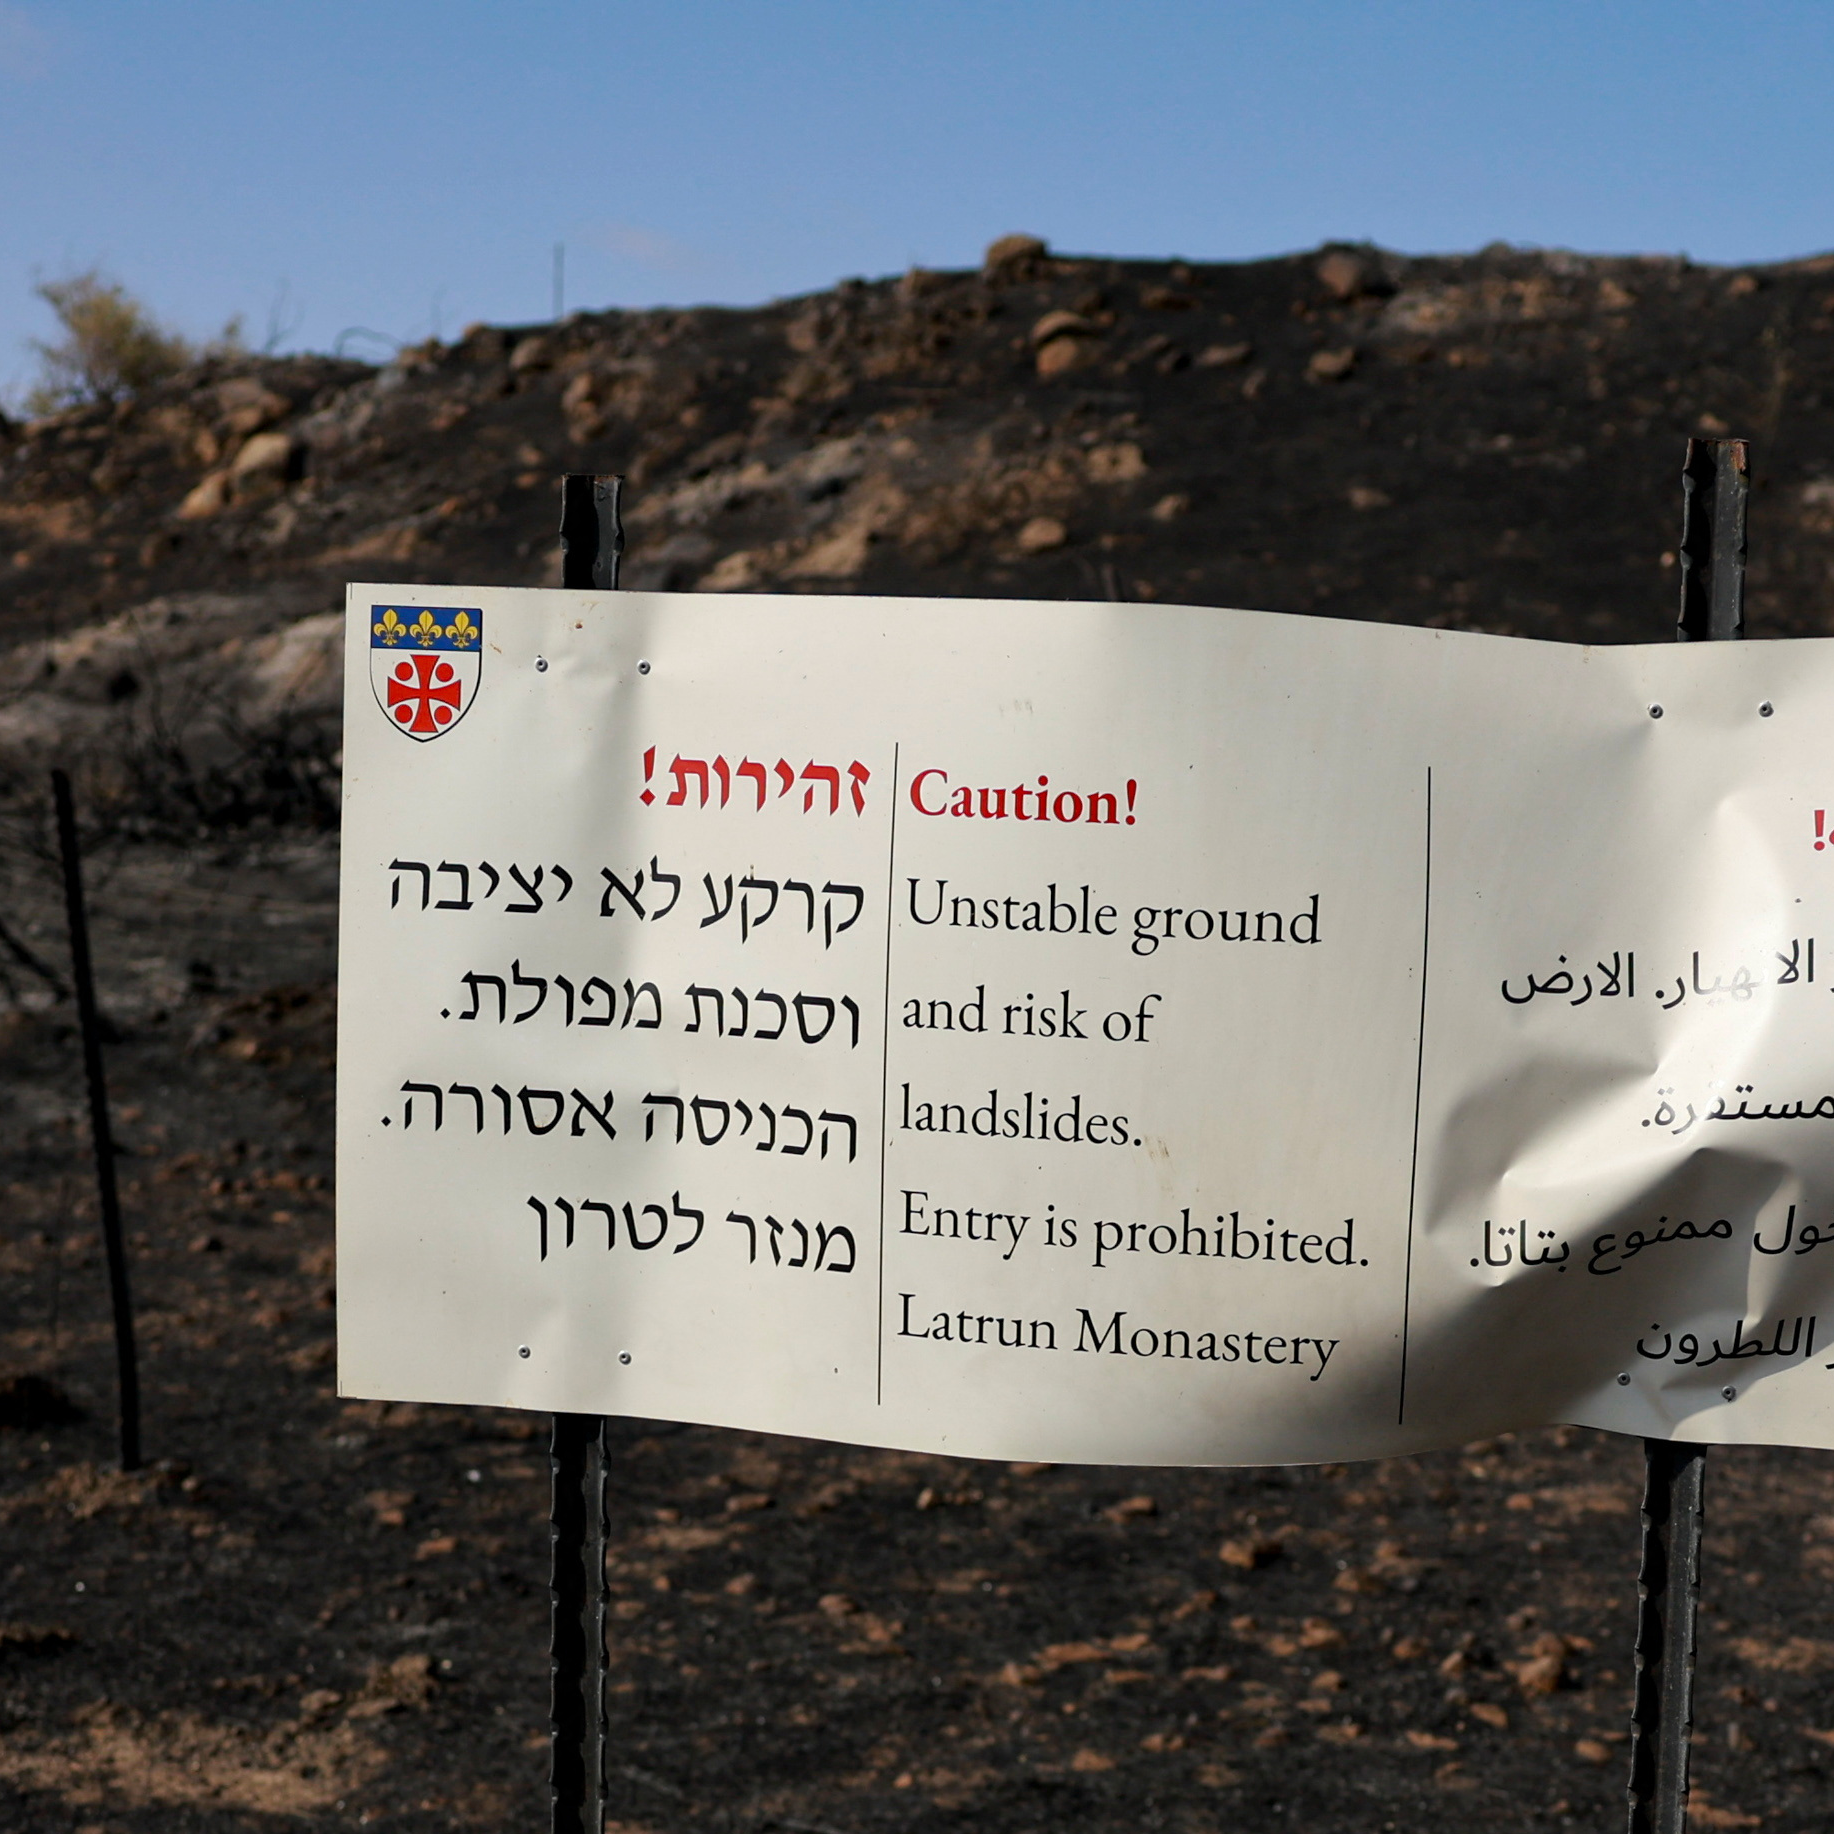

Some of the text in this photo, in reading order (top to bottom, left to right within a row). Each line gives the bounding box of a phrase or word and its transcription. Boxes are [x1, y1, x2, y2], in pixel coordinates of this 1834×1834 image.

[640, 745, 870, 816] זהירות!
[910, 769, 1137, 825] Caution!
[389, 856, 864, 949] קרקע לא יציבה
[907, 878, 1321, 956] Unstable ground
[441, 959, 859, 1049] וסכנת מפולת.
[1502, 951, 1634, 1006] الارض
[1656, 938, 1814, 1010] الاهيار.
[903, 985, 1162, 1042] and risk of
[381, 1080, 857, 1163] הכניסה אסורה.
[901, 1083, 1141, 1146] landslides.
[527, 1191, 856, 1273] מנזר לטרון
[900, 1190, 1368, 1268] Entry is prohibited.
[1470, 1220, 1569, 1272] بتاتا.
[1587, 1212, 1733, 1275] ممنوع
[897, 1293, 1340, 1382] Latrun Monastery
[1636, 1315, 1816, 1367] اللطرون
